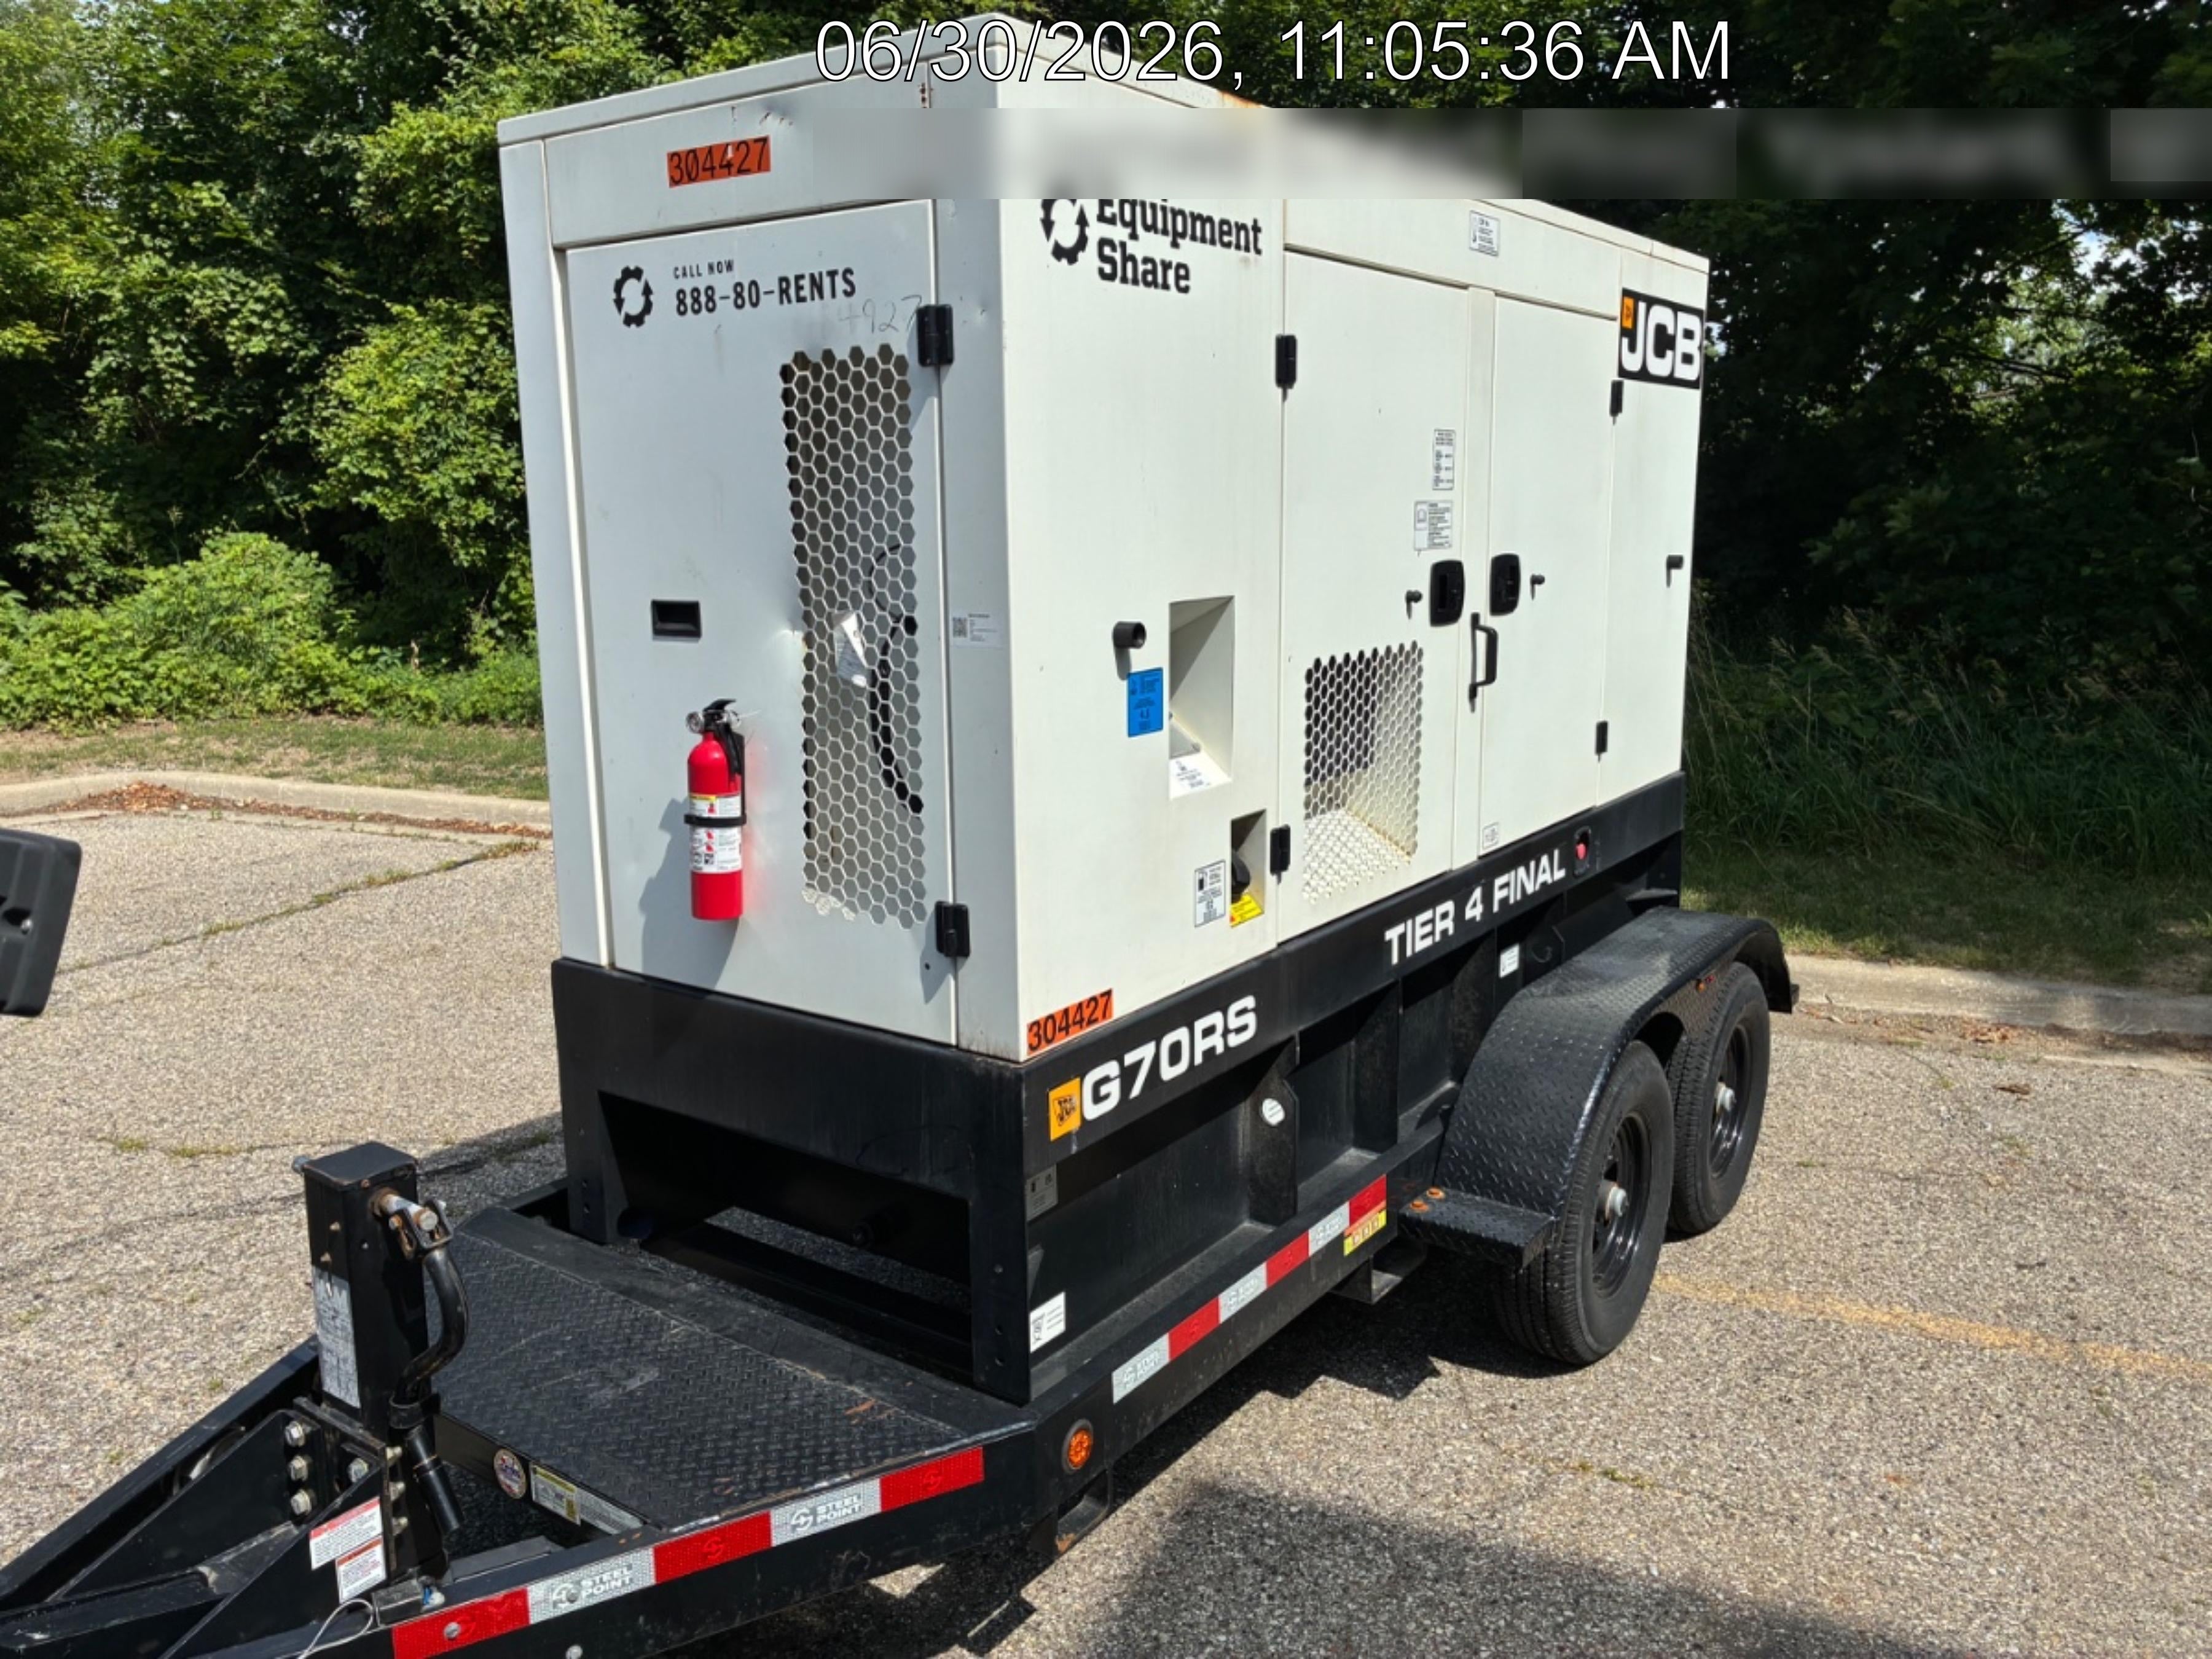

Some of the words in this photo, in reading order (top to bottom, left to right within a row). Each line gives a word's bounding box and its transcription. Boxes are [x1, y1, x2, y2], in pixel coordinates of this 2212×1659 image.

[670, 137, 769, 184] 304427
[1096, 199, 1262, 256] Equipment
[673, 264, 702, 280] CALL
[707, 259, 734, 275] NOW
[675, 267, 856, 316] 888-80-RENTS
[1097, 237, 1191, 294] Share
[1621, 300, 1702, 381] JCB
[1384, 900, 1456, 966] TIER
[1464, 885, 1483, 922] 4
[1492, 849, 1566, 914] FINAL
[1029, 991, 1112, 1051] 304427
[1081, 994, 1257, 1121] G70RS
